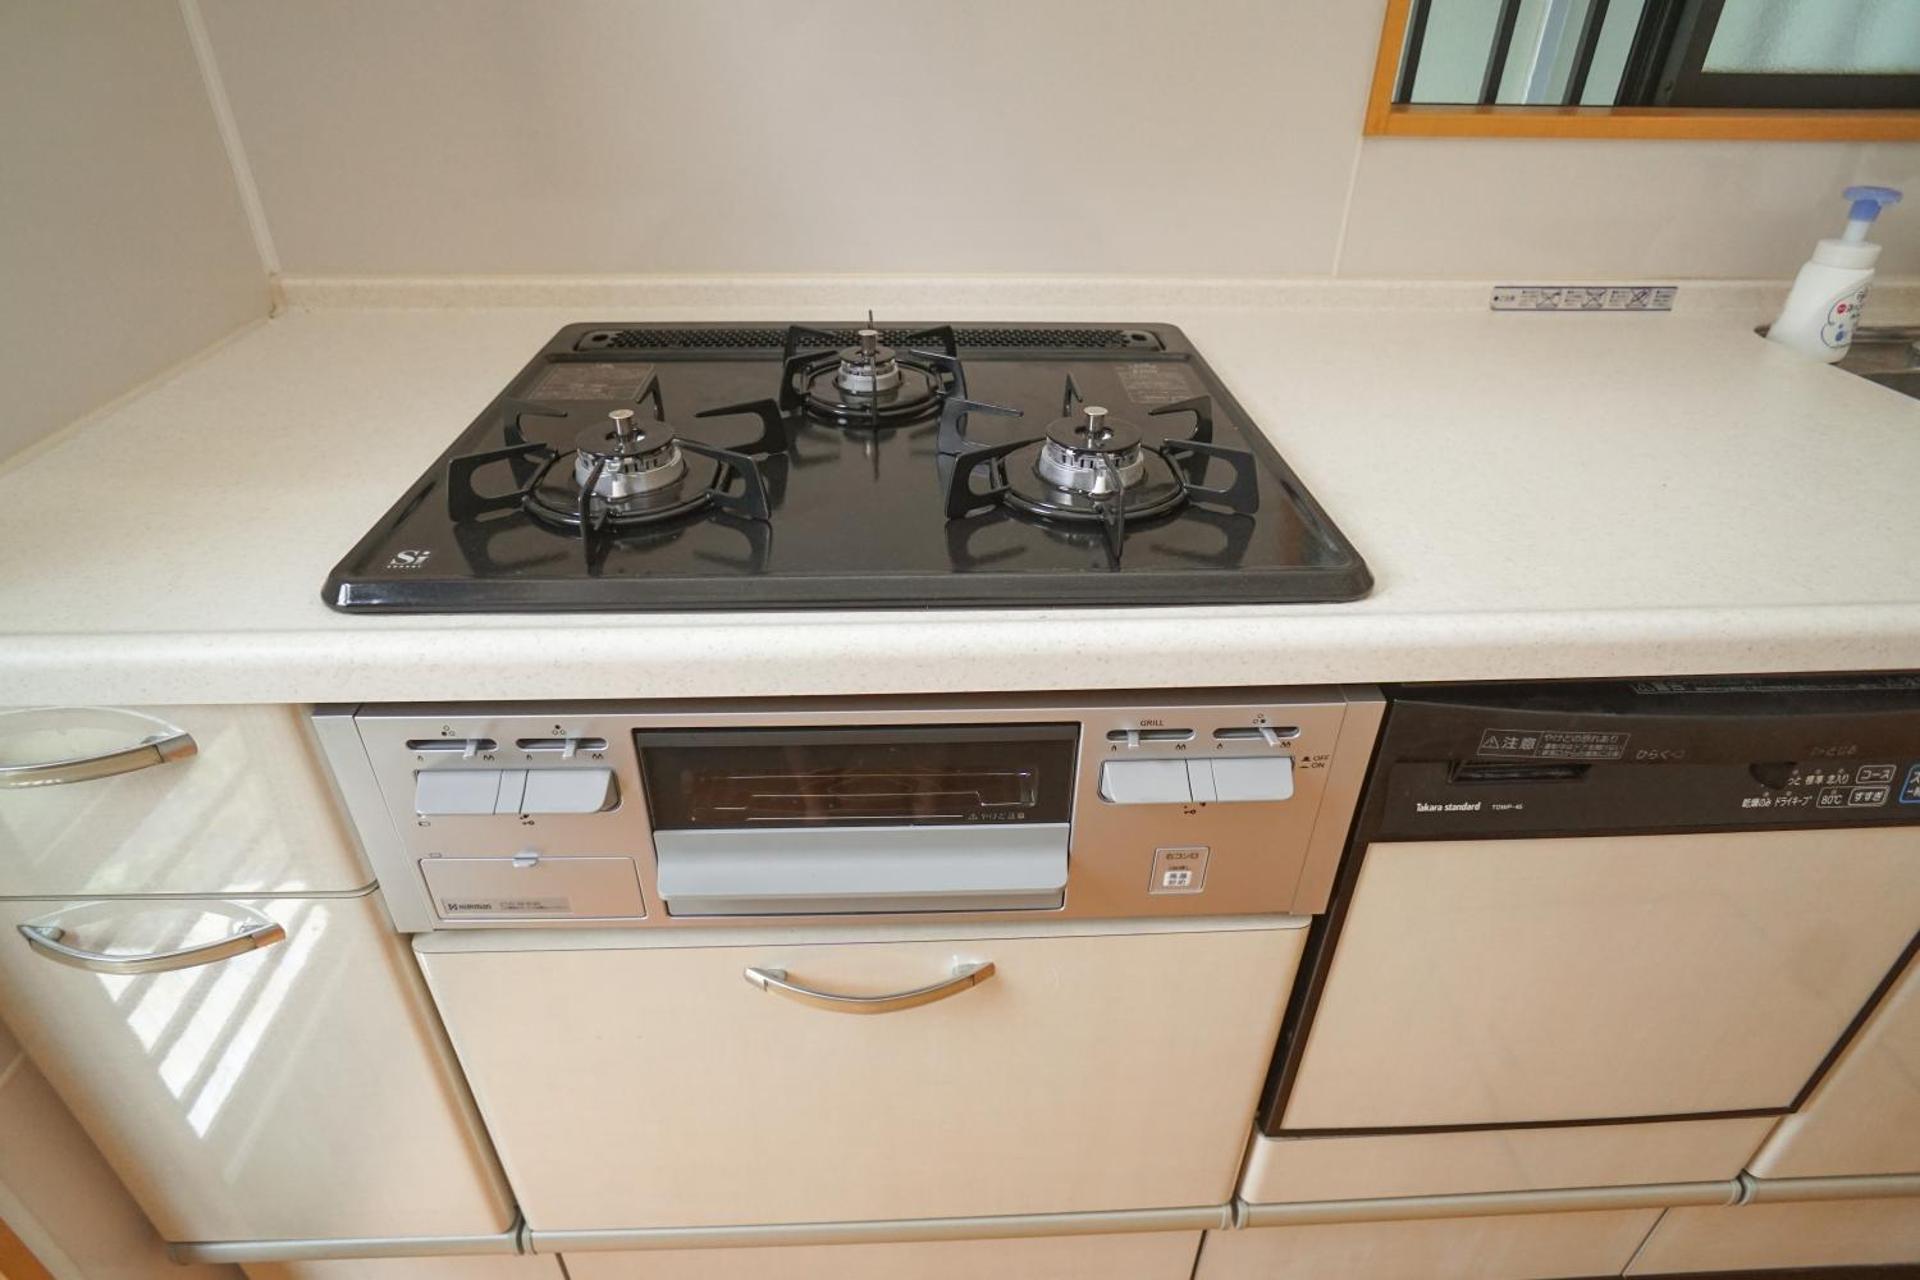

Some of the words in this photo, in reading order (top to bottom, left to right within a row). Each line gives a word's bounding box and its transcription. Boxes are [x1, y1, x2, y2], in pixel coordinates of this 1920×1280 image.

[1139, 719, 1165, 727] GRILL
[1501, 736, 1538, 750] 注意
[1860, 769, 1892, 780] コース
[1773, 795, 1813, 807] ドライキープ
[1854, 791, 1885, 802] すすぎ
[1416, 802, 1443, 812] Takara
[1443, 801, 1482, 812] standard
